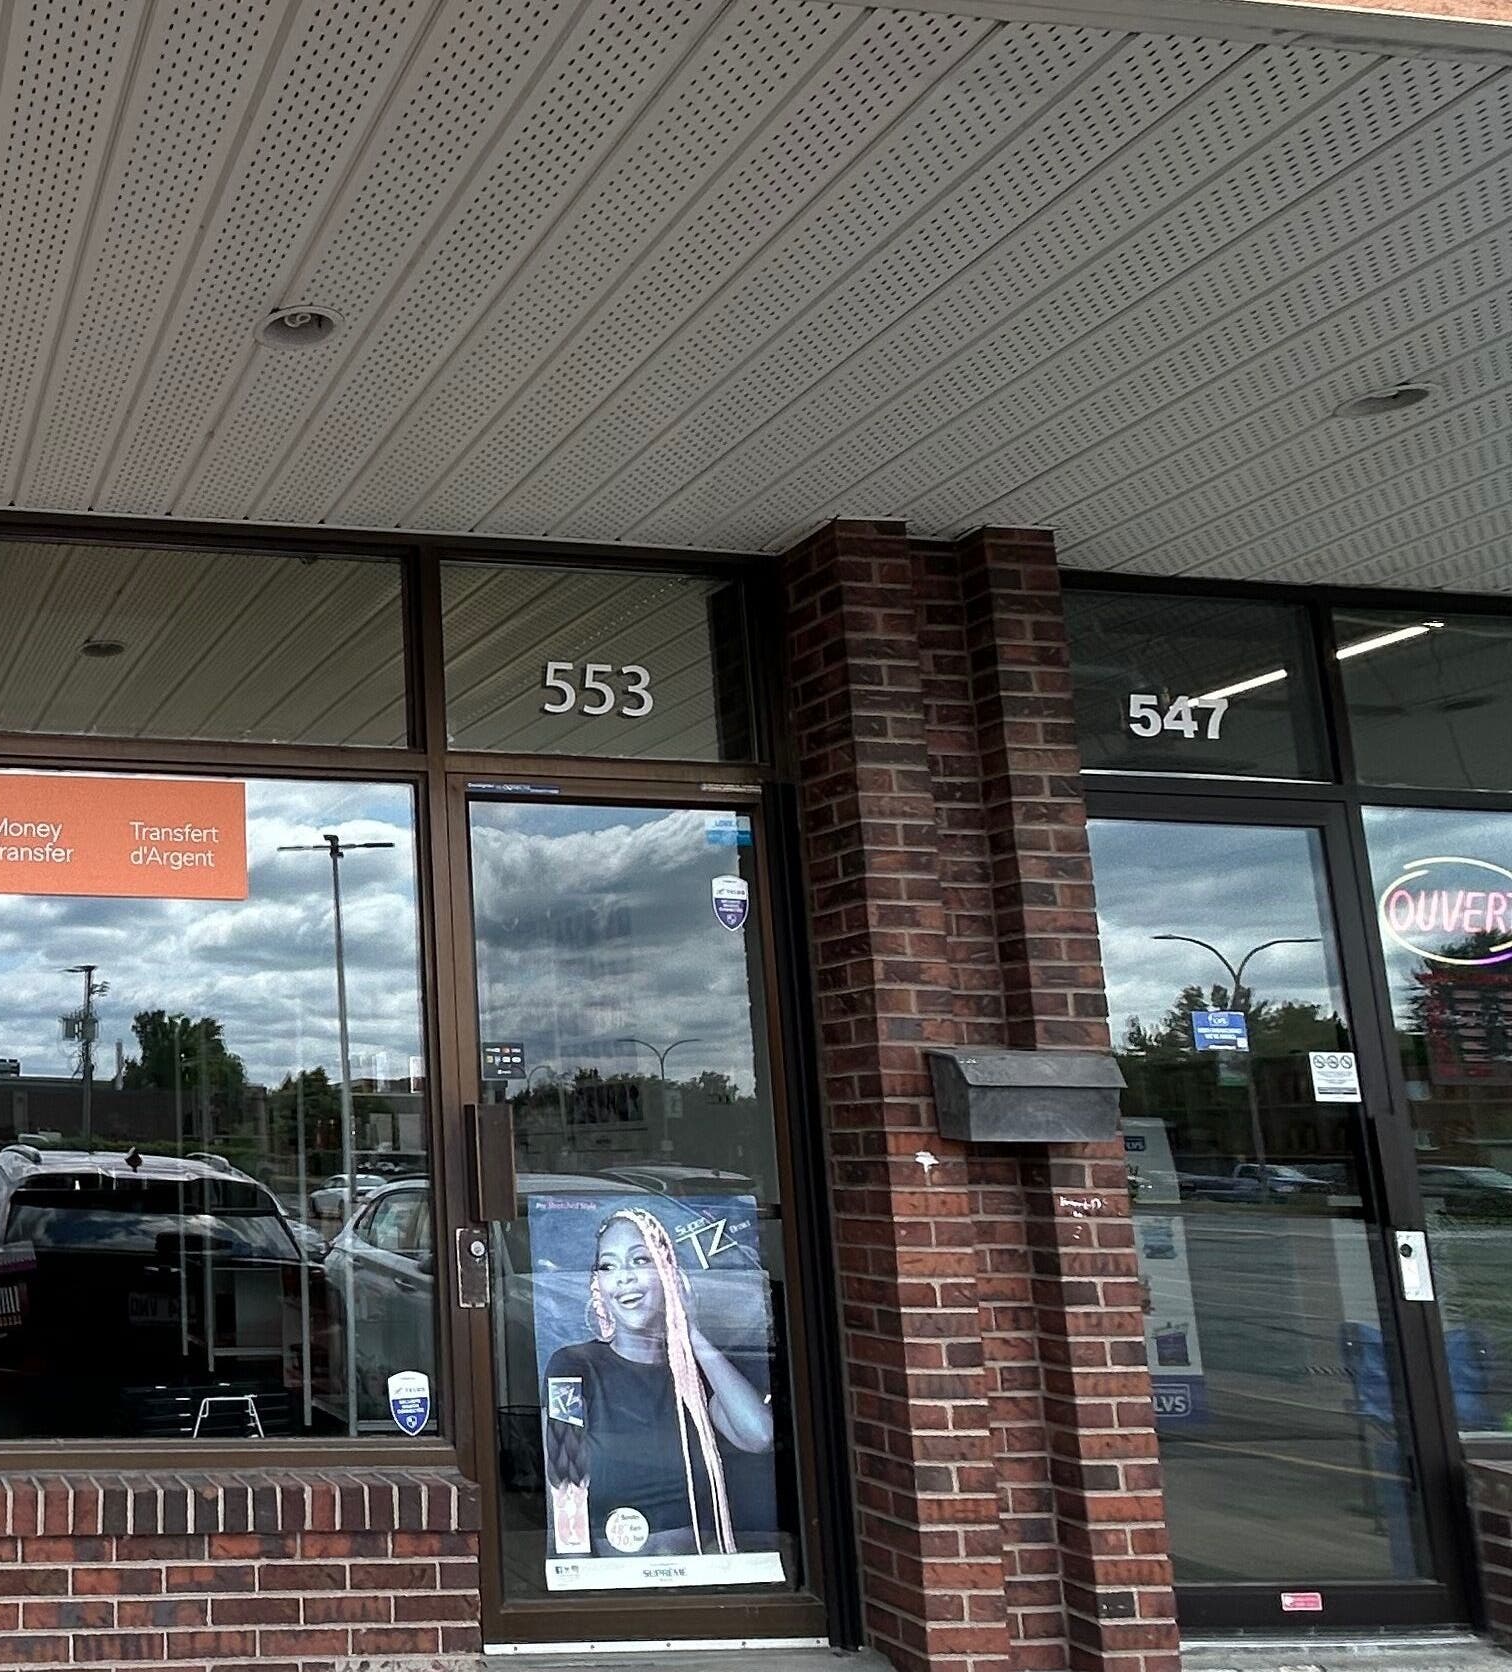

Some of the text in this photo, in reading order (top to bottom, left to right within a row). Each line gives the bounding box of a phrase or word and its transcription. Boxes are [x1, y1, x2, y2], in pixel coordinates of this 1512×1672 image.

[543, 661, 654, 717] 553
[1129, 694, 1229, 739] 547
[129, 821, 219, 844] Transfert
[130, 846, 216, 869] d'Argent
[675, 1218, 738, 1270] TZ
